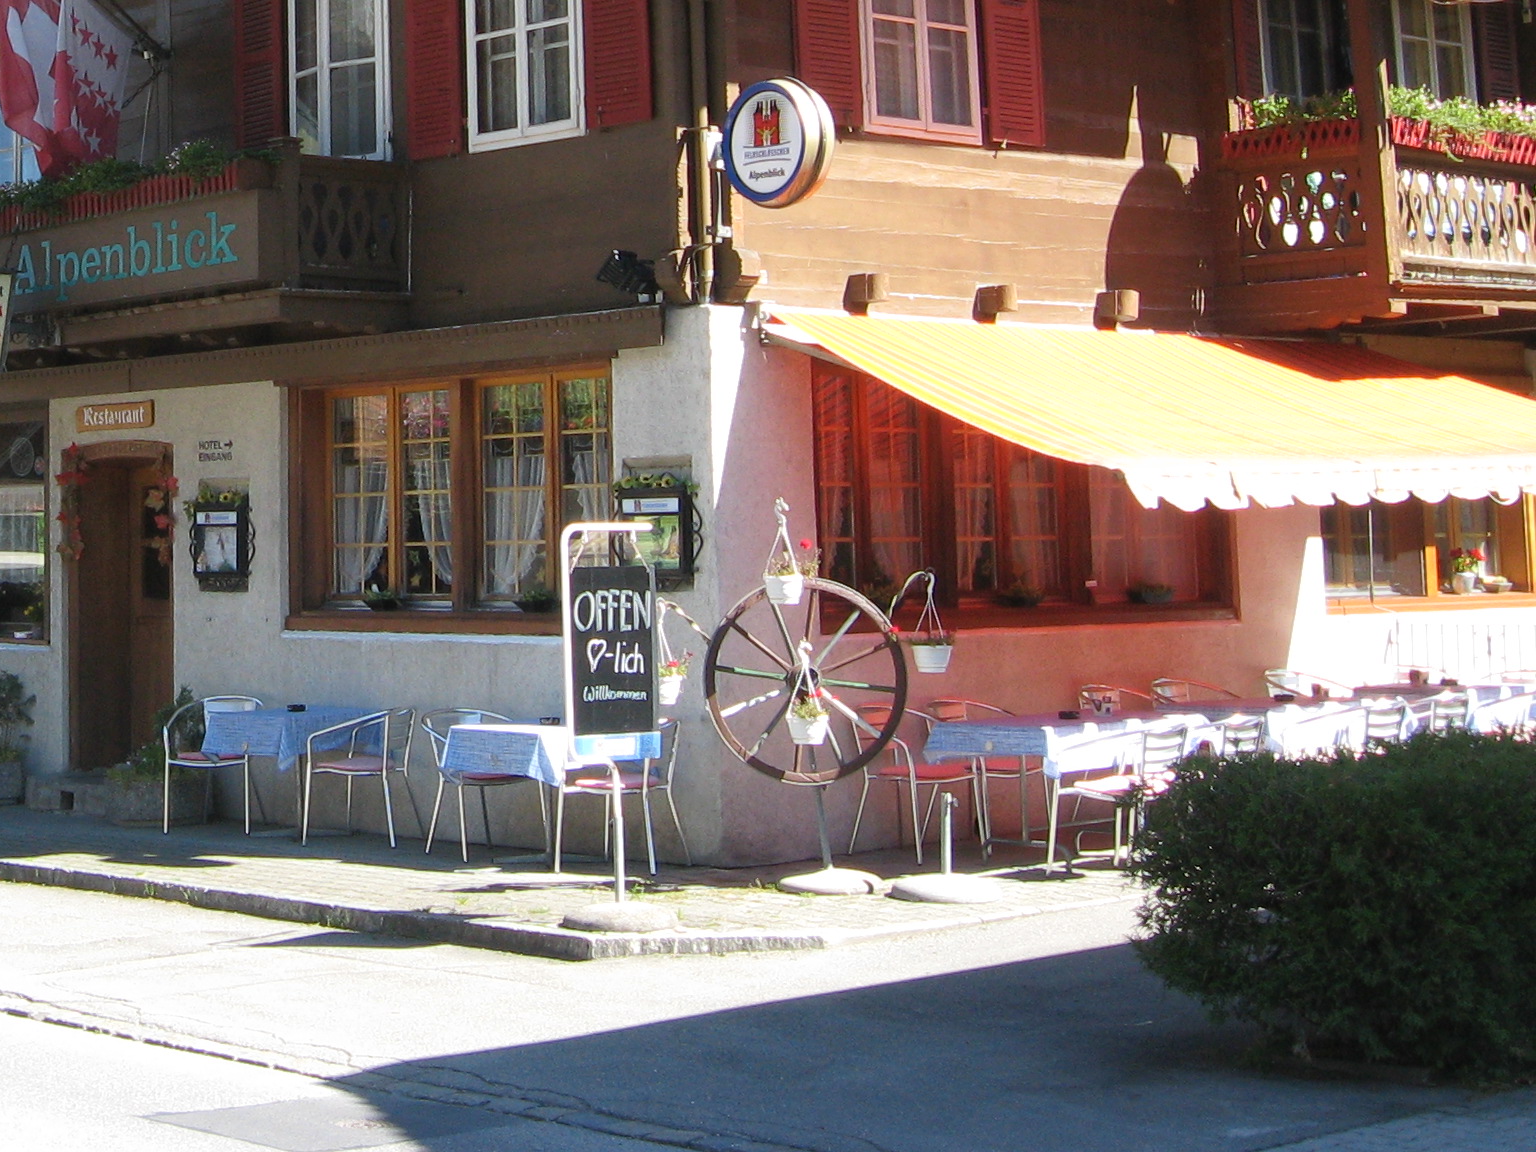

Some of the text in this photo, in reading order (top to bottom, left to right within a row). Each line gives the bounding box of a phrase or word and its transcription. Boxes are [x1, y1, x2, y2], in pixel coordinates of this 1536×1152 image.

[749, 167, 785, 182] Alpenblick
[15, 211, 238, 301] Alpenblick
[84, 406, 145, 426] Restaurant
[198, 441, 222, 450] HOTEL
[198, 452, 232, 462] EINGANG
[574, 589, 651, 632] OFFEN
[583, 684, 647, 702] Willkommen
